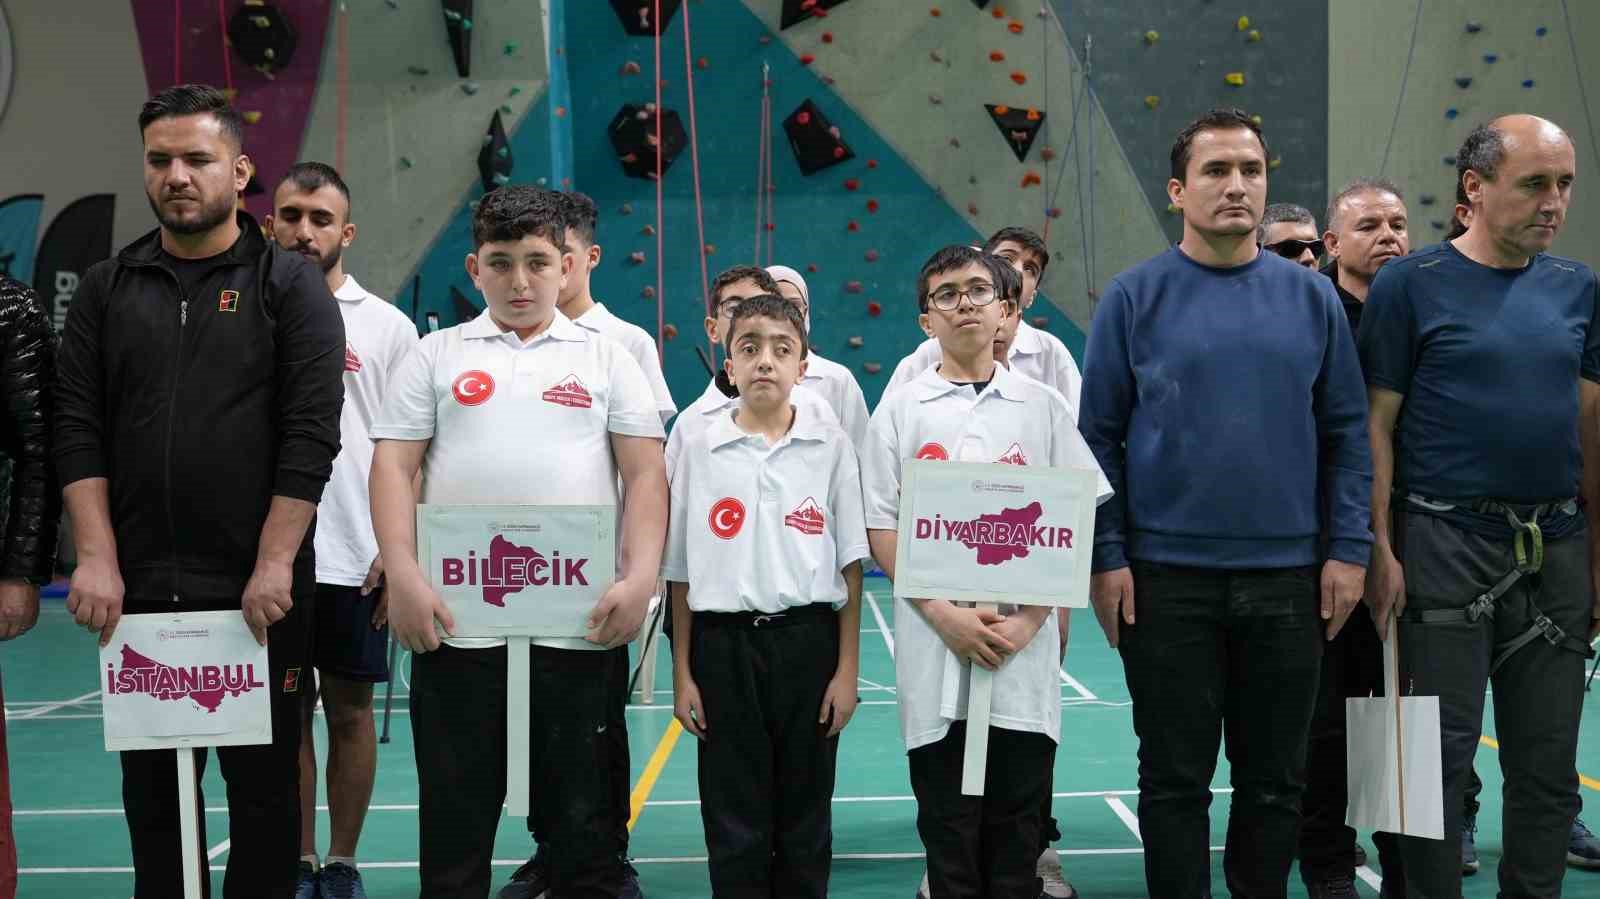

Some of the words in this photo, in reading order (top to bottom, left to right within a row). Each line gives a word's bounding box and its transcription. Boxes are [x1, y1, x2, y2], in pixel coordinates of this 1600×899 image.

[915, 513, 1073, 549] DİYARBAKIR
[441, 549, 590, 587] BİLECİK
[107, 662, 265, 695] İSTANBUL
